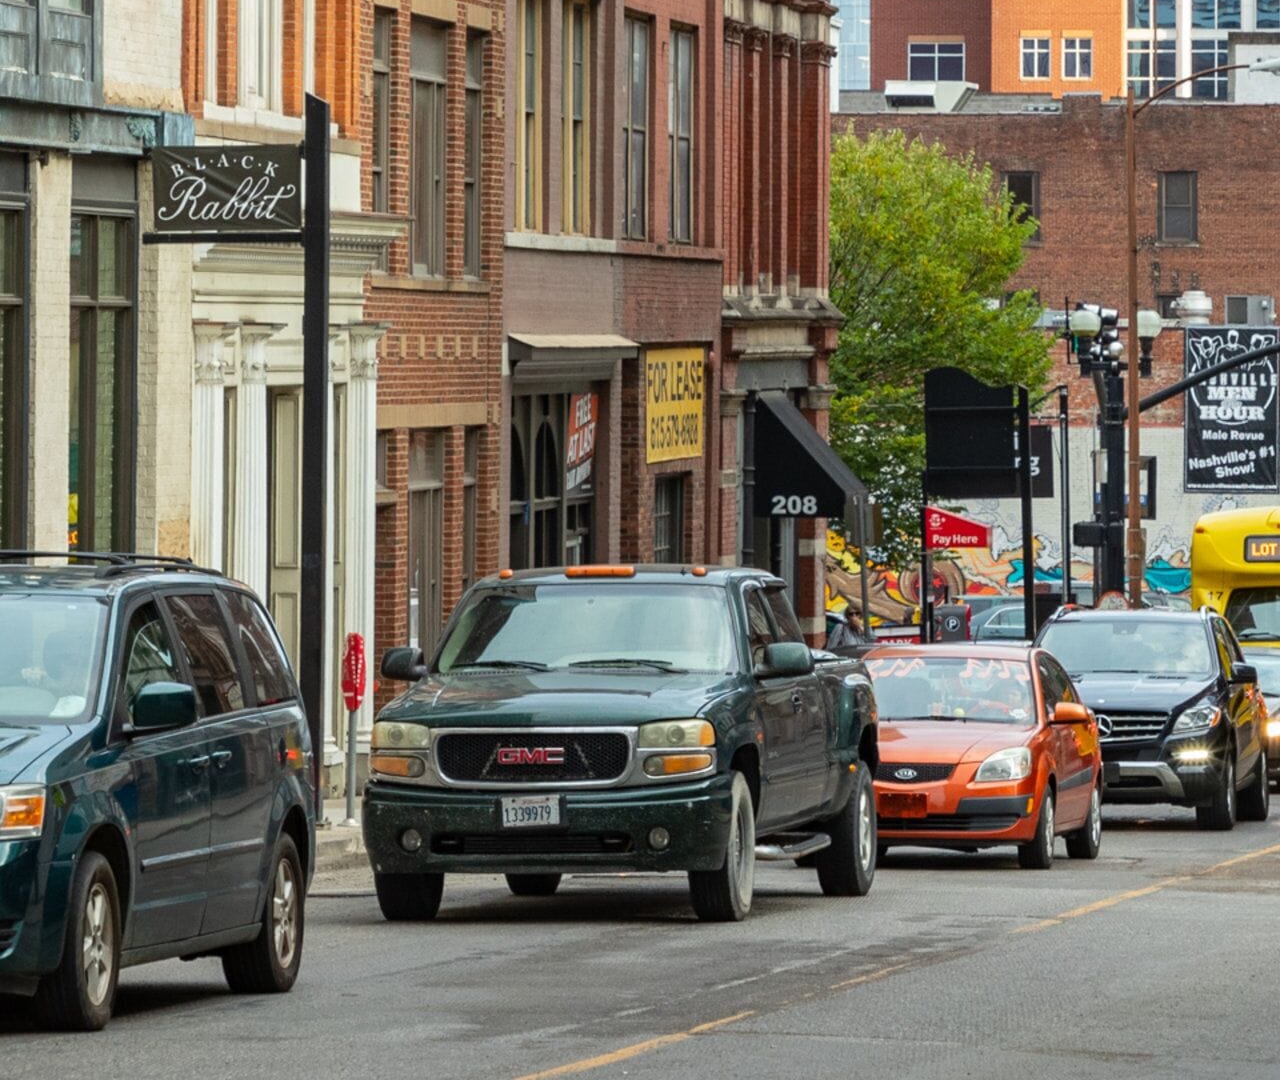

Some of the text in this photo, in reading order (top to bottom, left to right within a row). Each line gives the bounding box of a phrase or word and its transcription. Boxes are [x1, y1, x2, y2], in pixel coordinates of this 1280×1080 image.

[158, 176, 297, 221] Rabbit
[647, 360, 703, 404] FOR LEASE
[1188, 372, 1279, 387] SHVILLE
[1206, 386, 1258, 401] MEN
[1199, 405, 1266, 421] HOUR
[1202, 429, 1265, 441] Male Revue
[1188, 444, 1276, 471] Nashville's #1
[1214, 461, 1256, 479] Show!
[770, 495, 818, 515] 208
[932, 534, 979, 547] Pay Here
[1251, 542, 1278, 556] LOT
[497, 747, 565, 765] GMC
